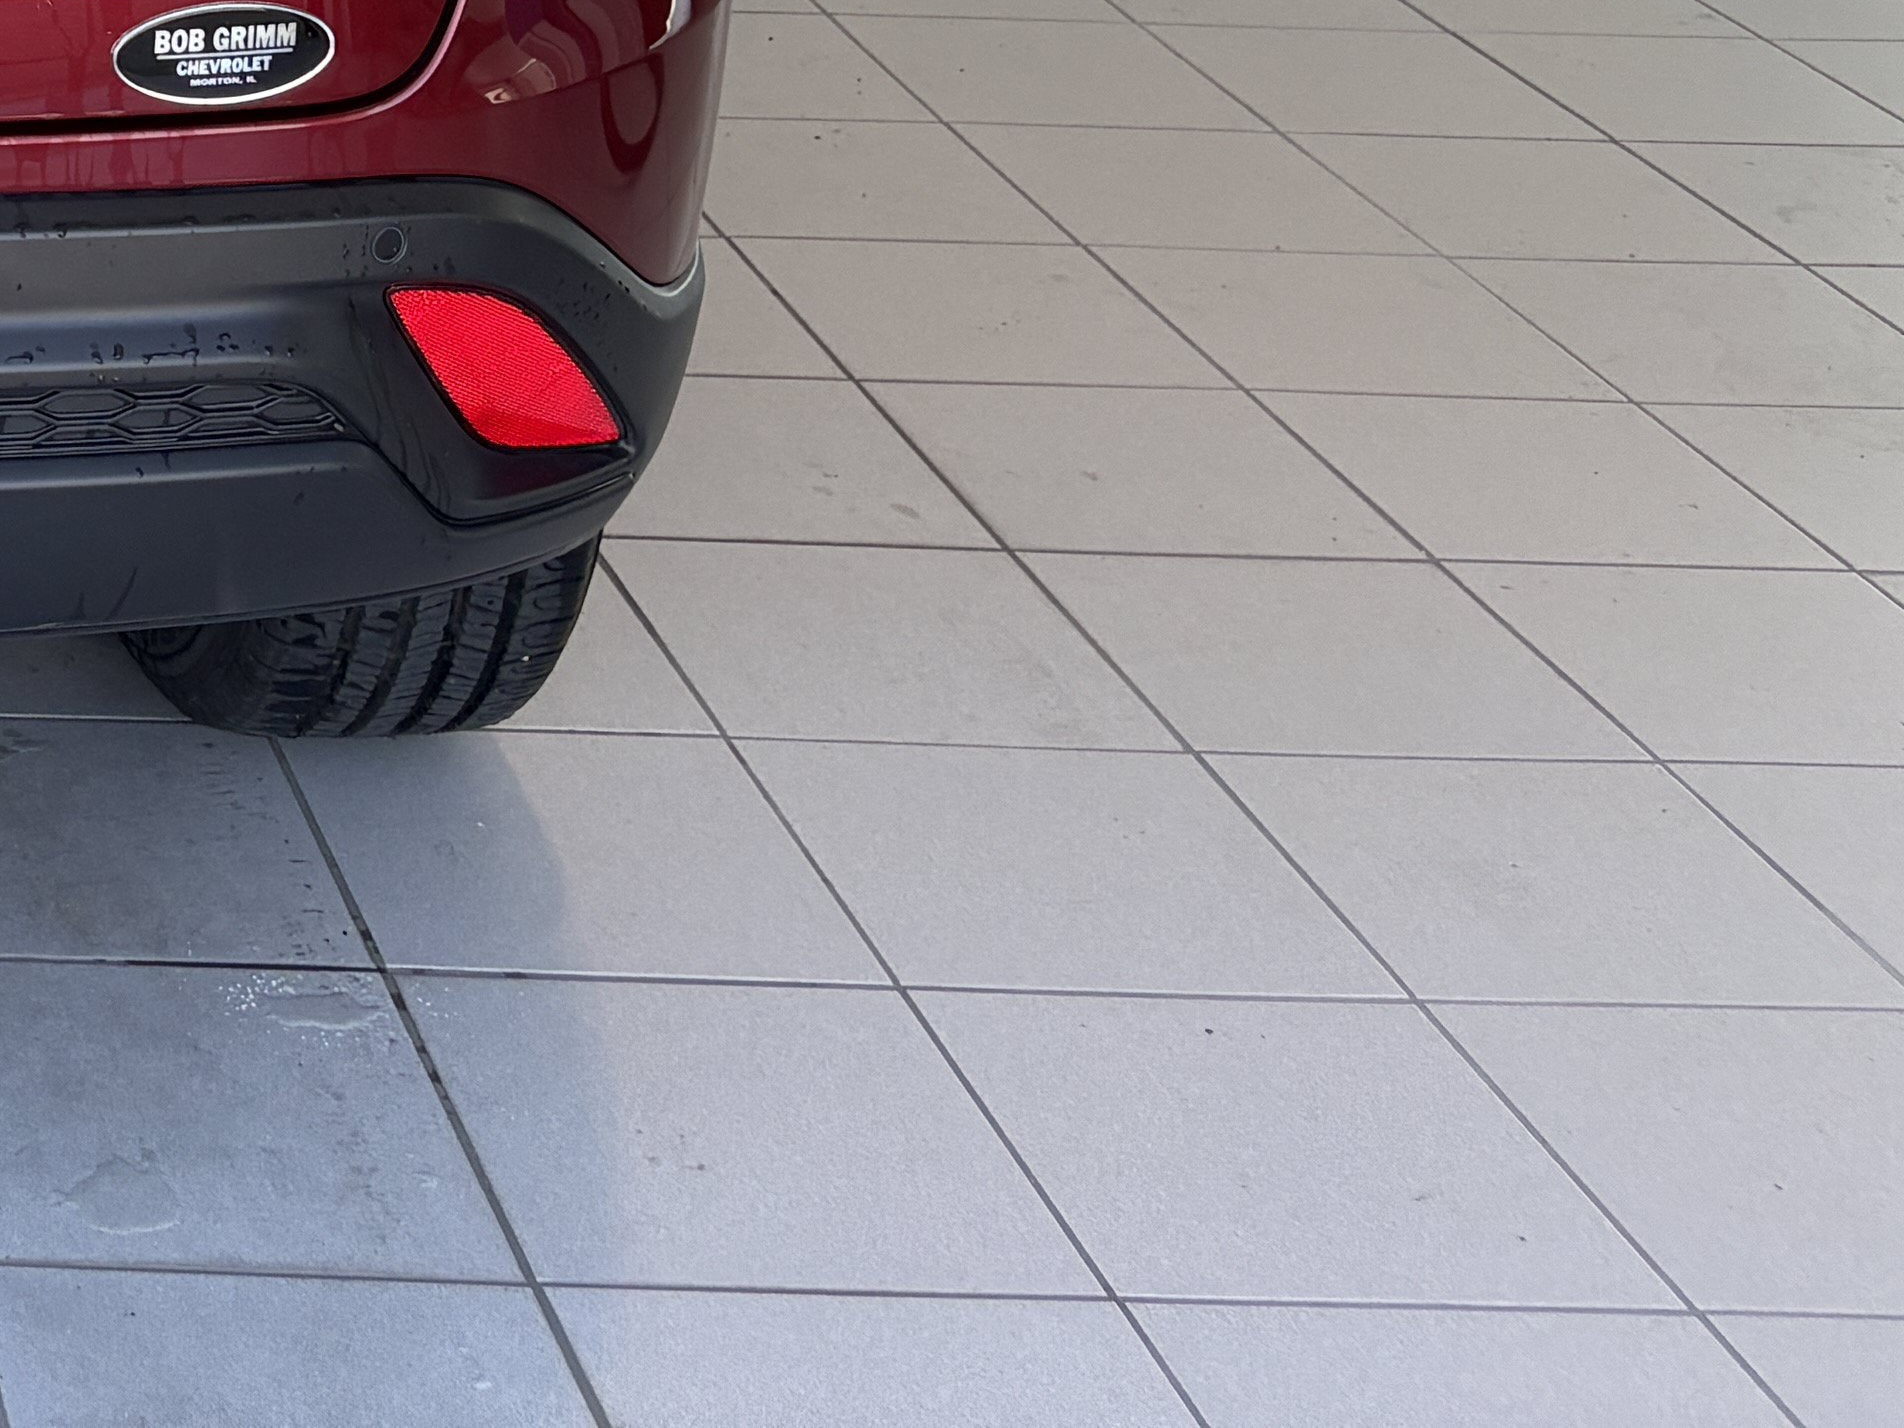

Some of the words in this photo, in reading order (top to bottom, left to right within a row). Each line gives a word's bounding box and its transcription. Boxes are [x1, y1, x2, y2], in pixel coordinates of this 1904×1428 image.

[154, 29, 206, 55] BOB
[213, 22, 298, 52] GRIMM
[176, 56, 273, 77] CHEVROLET
[189, 75, 244, 87] MORTON,
